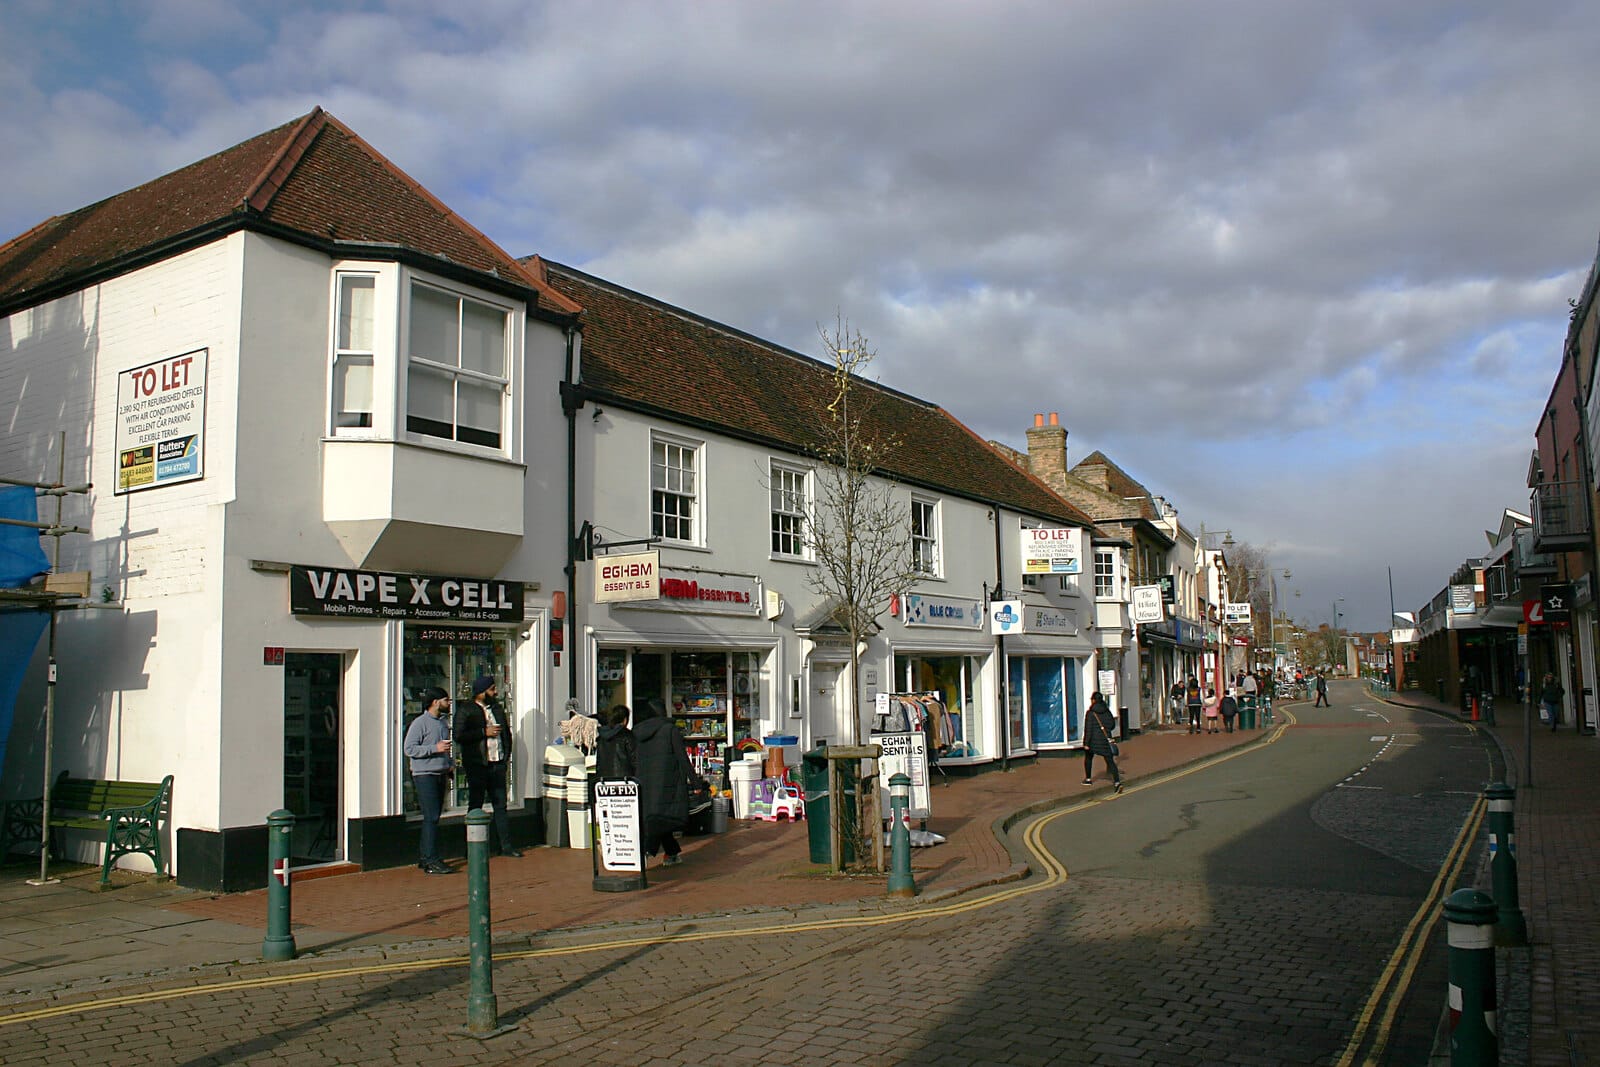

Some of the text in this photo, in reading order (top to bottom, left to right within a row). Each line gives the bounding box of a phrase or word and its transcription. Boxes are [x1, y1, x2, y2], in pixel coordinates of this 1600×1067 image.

[132, 357, 192, 399] TO LET
[133, 403, 140, 412] SQ
[141, 401, 146, 409] FT
[148, 392, 180, 407] REFURBISHED
[182, 386, 203, 399] OFFICES
[126, 400, 194, 424] WITH AIR CONDITIONING &
[128, 413, 191, 434] EXCELLENT CAR PARKING
[139, 428, 178, 443] FLEXIBLE TERMS
[160, 440, 185, 452] Butters
[1031, 530, 1071, 540] TO LET
[307, 570, 512, 609] VAPE X CELL
[660, 578, 698, 599] HAM
[324, 604, 346, 612] Mobile
[348, 605, 373, 614] Phones
[382, 606, 406, 616] Repairs
[415, 608, 450, 617] Accessories
[930, 605, 944, 617] BLUE
[459, 631, 471, 640] WE
[882, 737, 911, 746] EGHAM
[883, 746, 923, 756] SENTIALS
[598, 785, 635, 795] WE FIX
